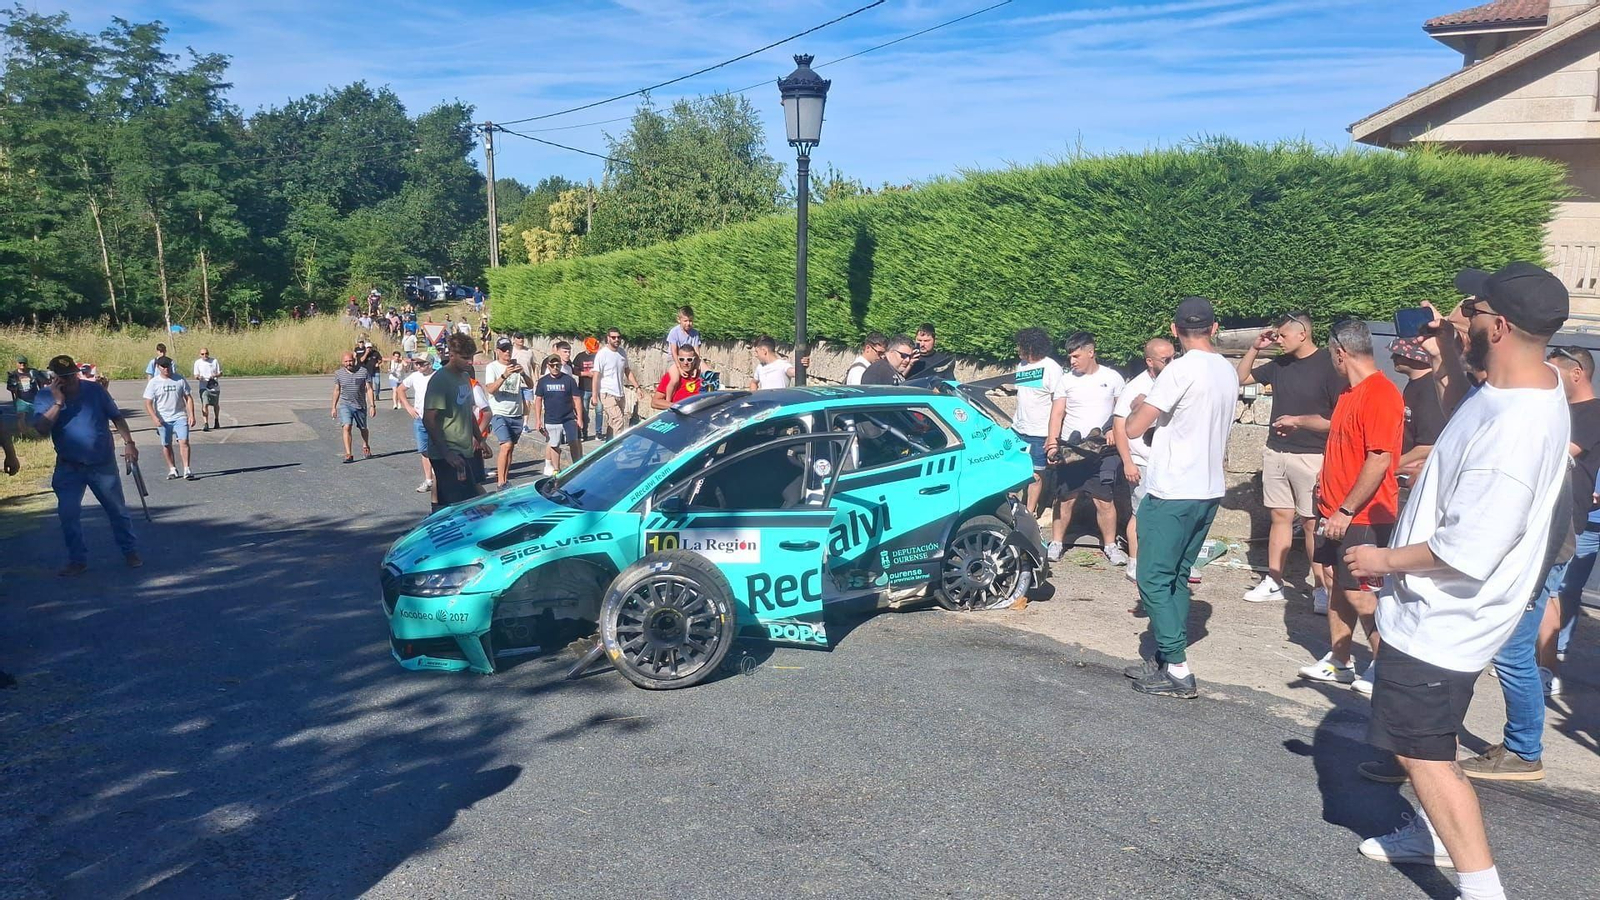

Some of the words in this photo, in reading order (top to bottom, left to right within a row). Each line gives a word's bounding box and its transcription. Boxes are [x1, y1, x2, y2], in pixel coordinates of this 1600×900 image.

[655, 467, 672, 482] Team
[649, 535, 678, 552] 10
[682, 539, 701, 551] La
[705, 538, 757, 555] Región
[892, 542, 939, 557] DEPUTACIÓN
[893, 552, 928, 564] OURENSE
[889, 569, 922, 579] ourense
[745, 568, 823, 615] Rec
[400, 608, 434, 621] Xacobeo
[449, 612, 469, 622] 2027
